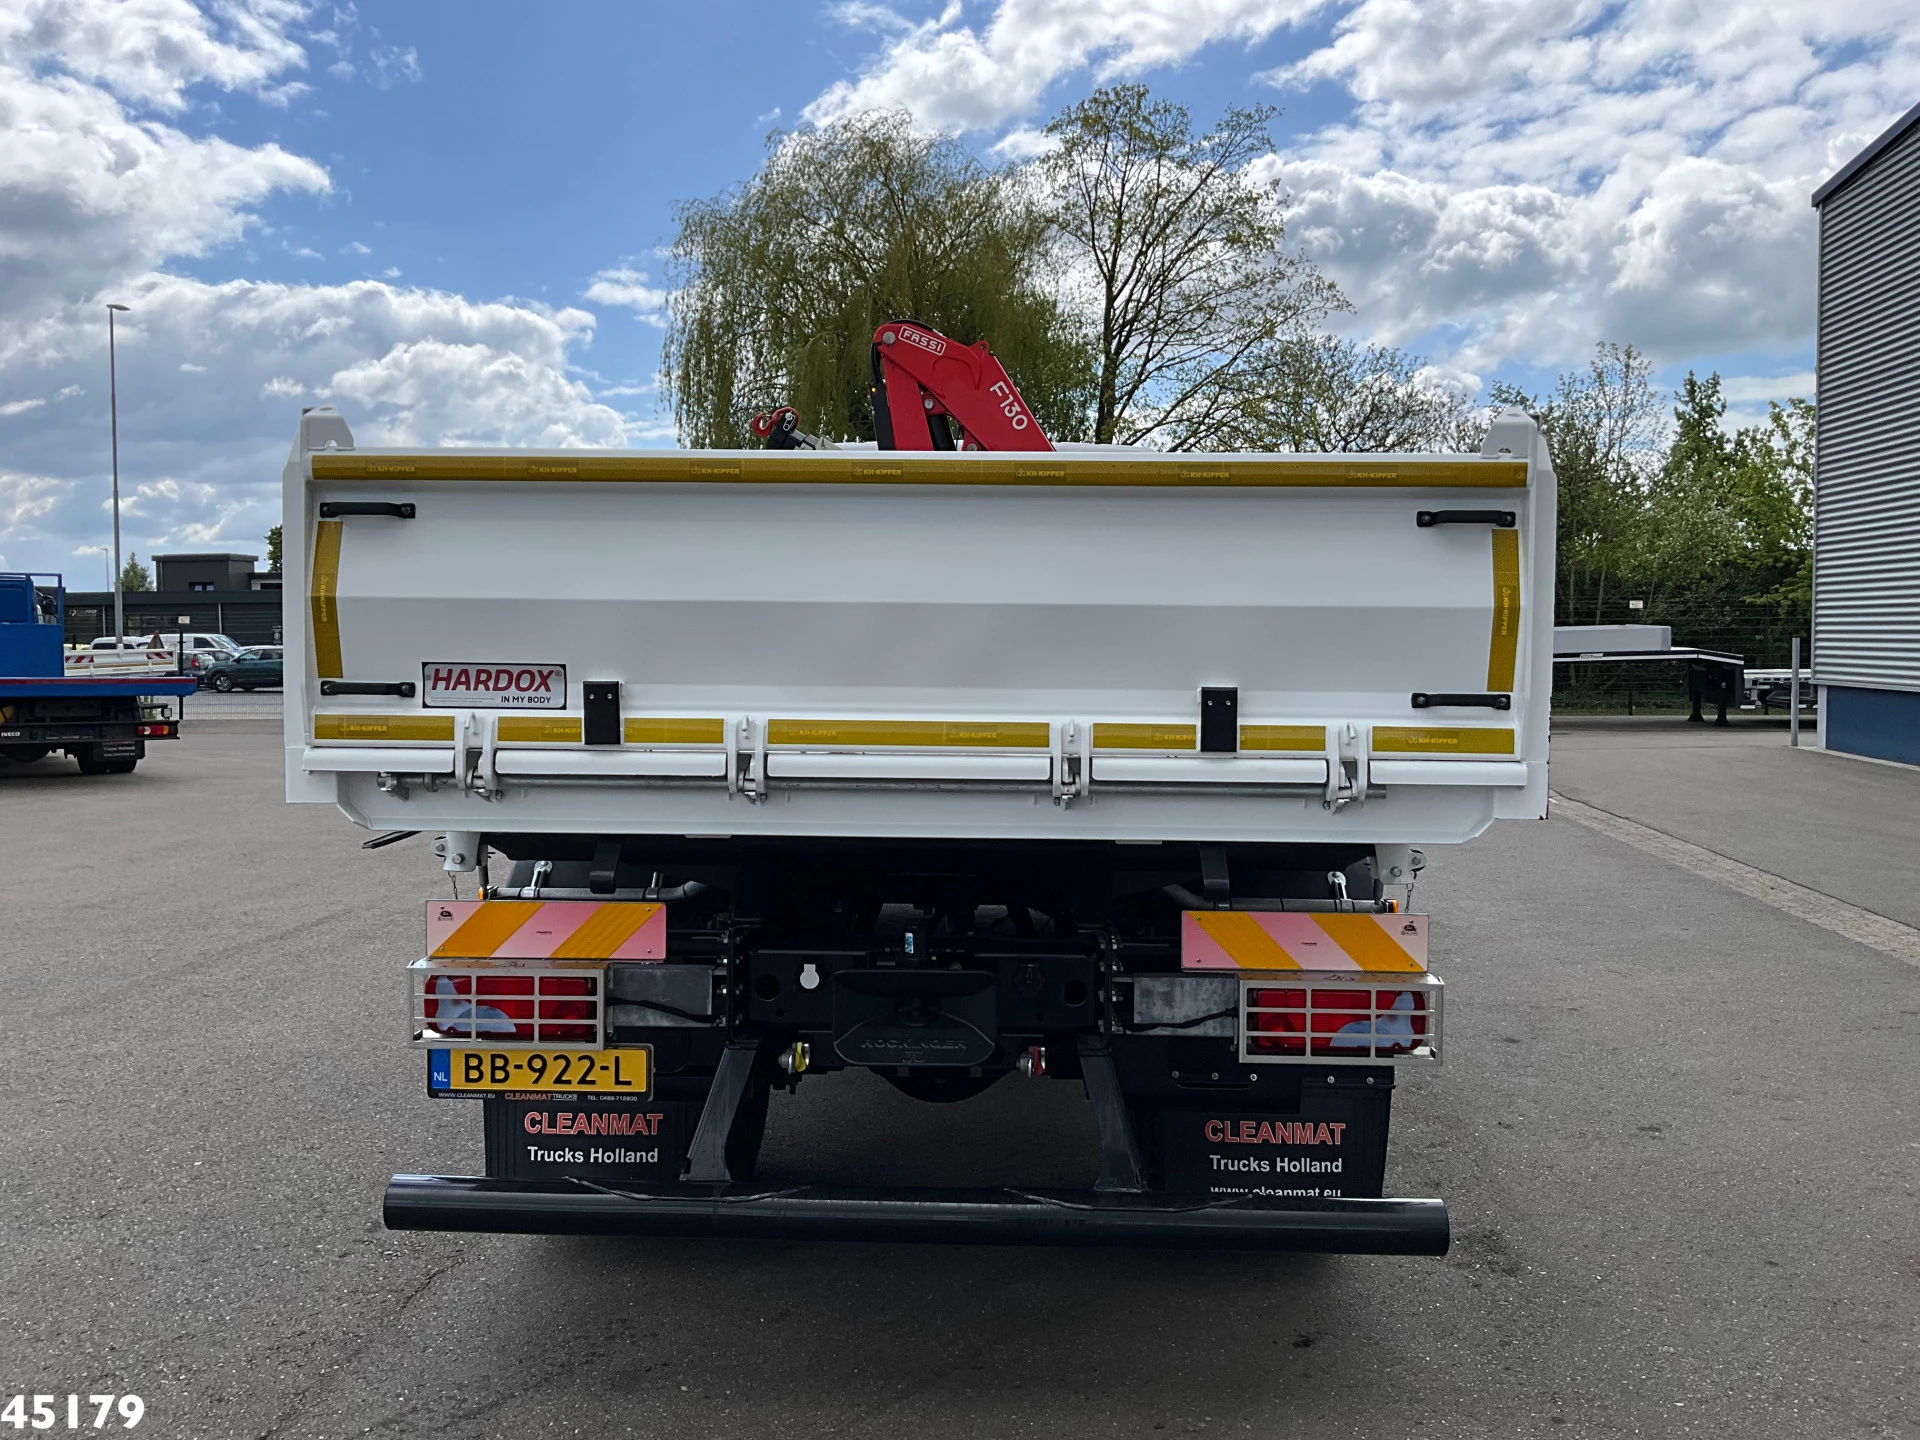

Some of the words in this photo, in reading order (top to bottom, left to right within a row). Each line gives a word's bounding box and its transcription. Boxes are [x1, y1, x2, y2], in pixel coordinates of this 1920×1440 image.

[903, 330, 942, 352] FASSI
[989, 381, 1028, 430] F130
[501, 695, 510, 703] IN
[527, 696, 552, 704] BODY
[433, 1071, 448, 1082] NL
[464, 1052, 633, 1087] BB-922-L
[524, 1111, 663, 1136] CLEANMAT
[1205, 1119, 1347, 1145] CLEANMAT
[527, 1145, 584, 1163] Trucks
[590, 1147, 659, 1164] Holland
[1209, 1154, 1270, 1172] Trucks
[1276, 1157, 1343, 1173] Holland
